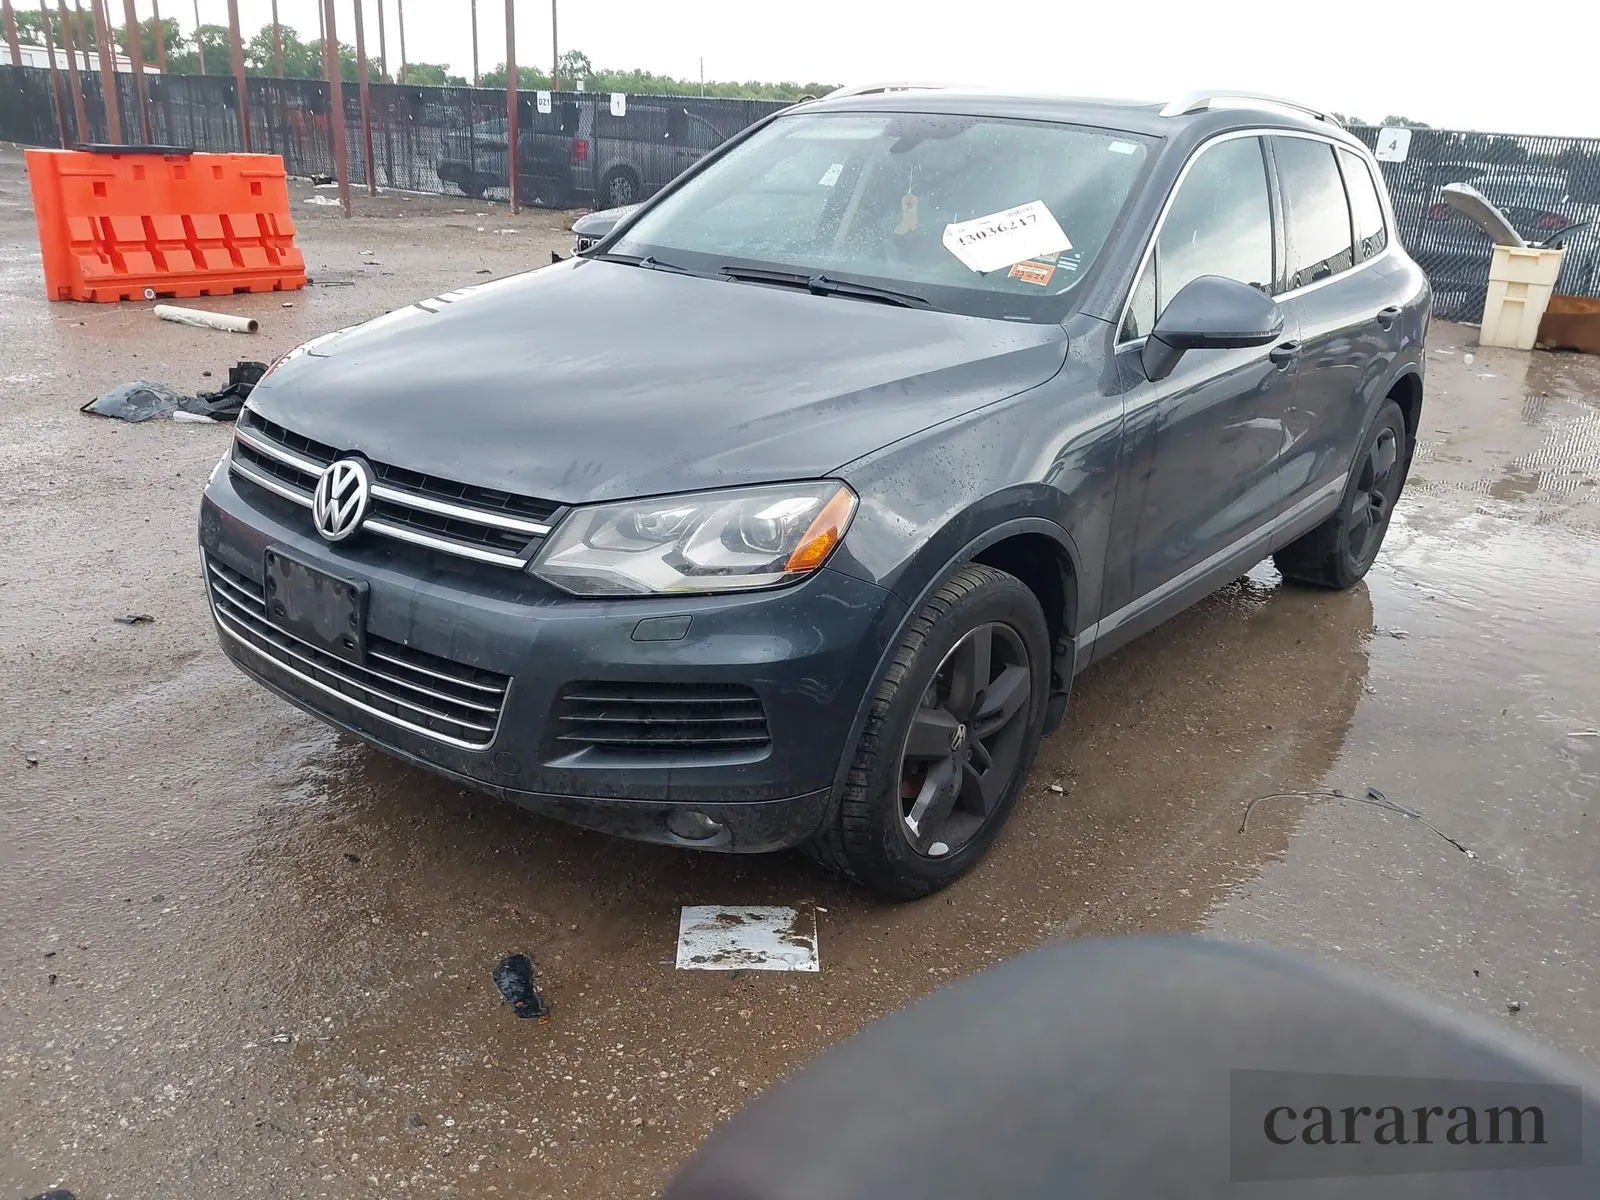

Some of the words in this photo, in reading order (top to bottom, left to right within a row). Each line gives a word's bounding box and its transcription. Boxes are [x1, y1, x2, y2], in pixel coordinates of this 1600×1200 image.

[1388, 140, 1397, 151] 4
[1034, 273, 1045, 281] 24
[315, 462, 366, 538] VW
